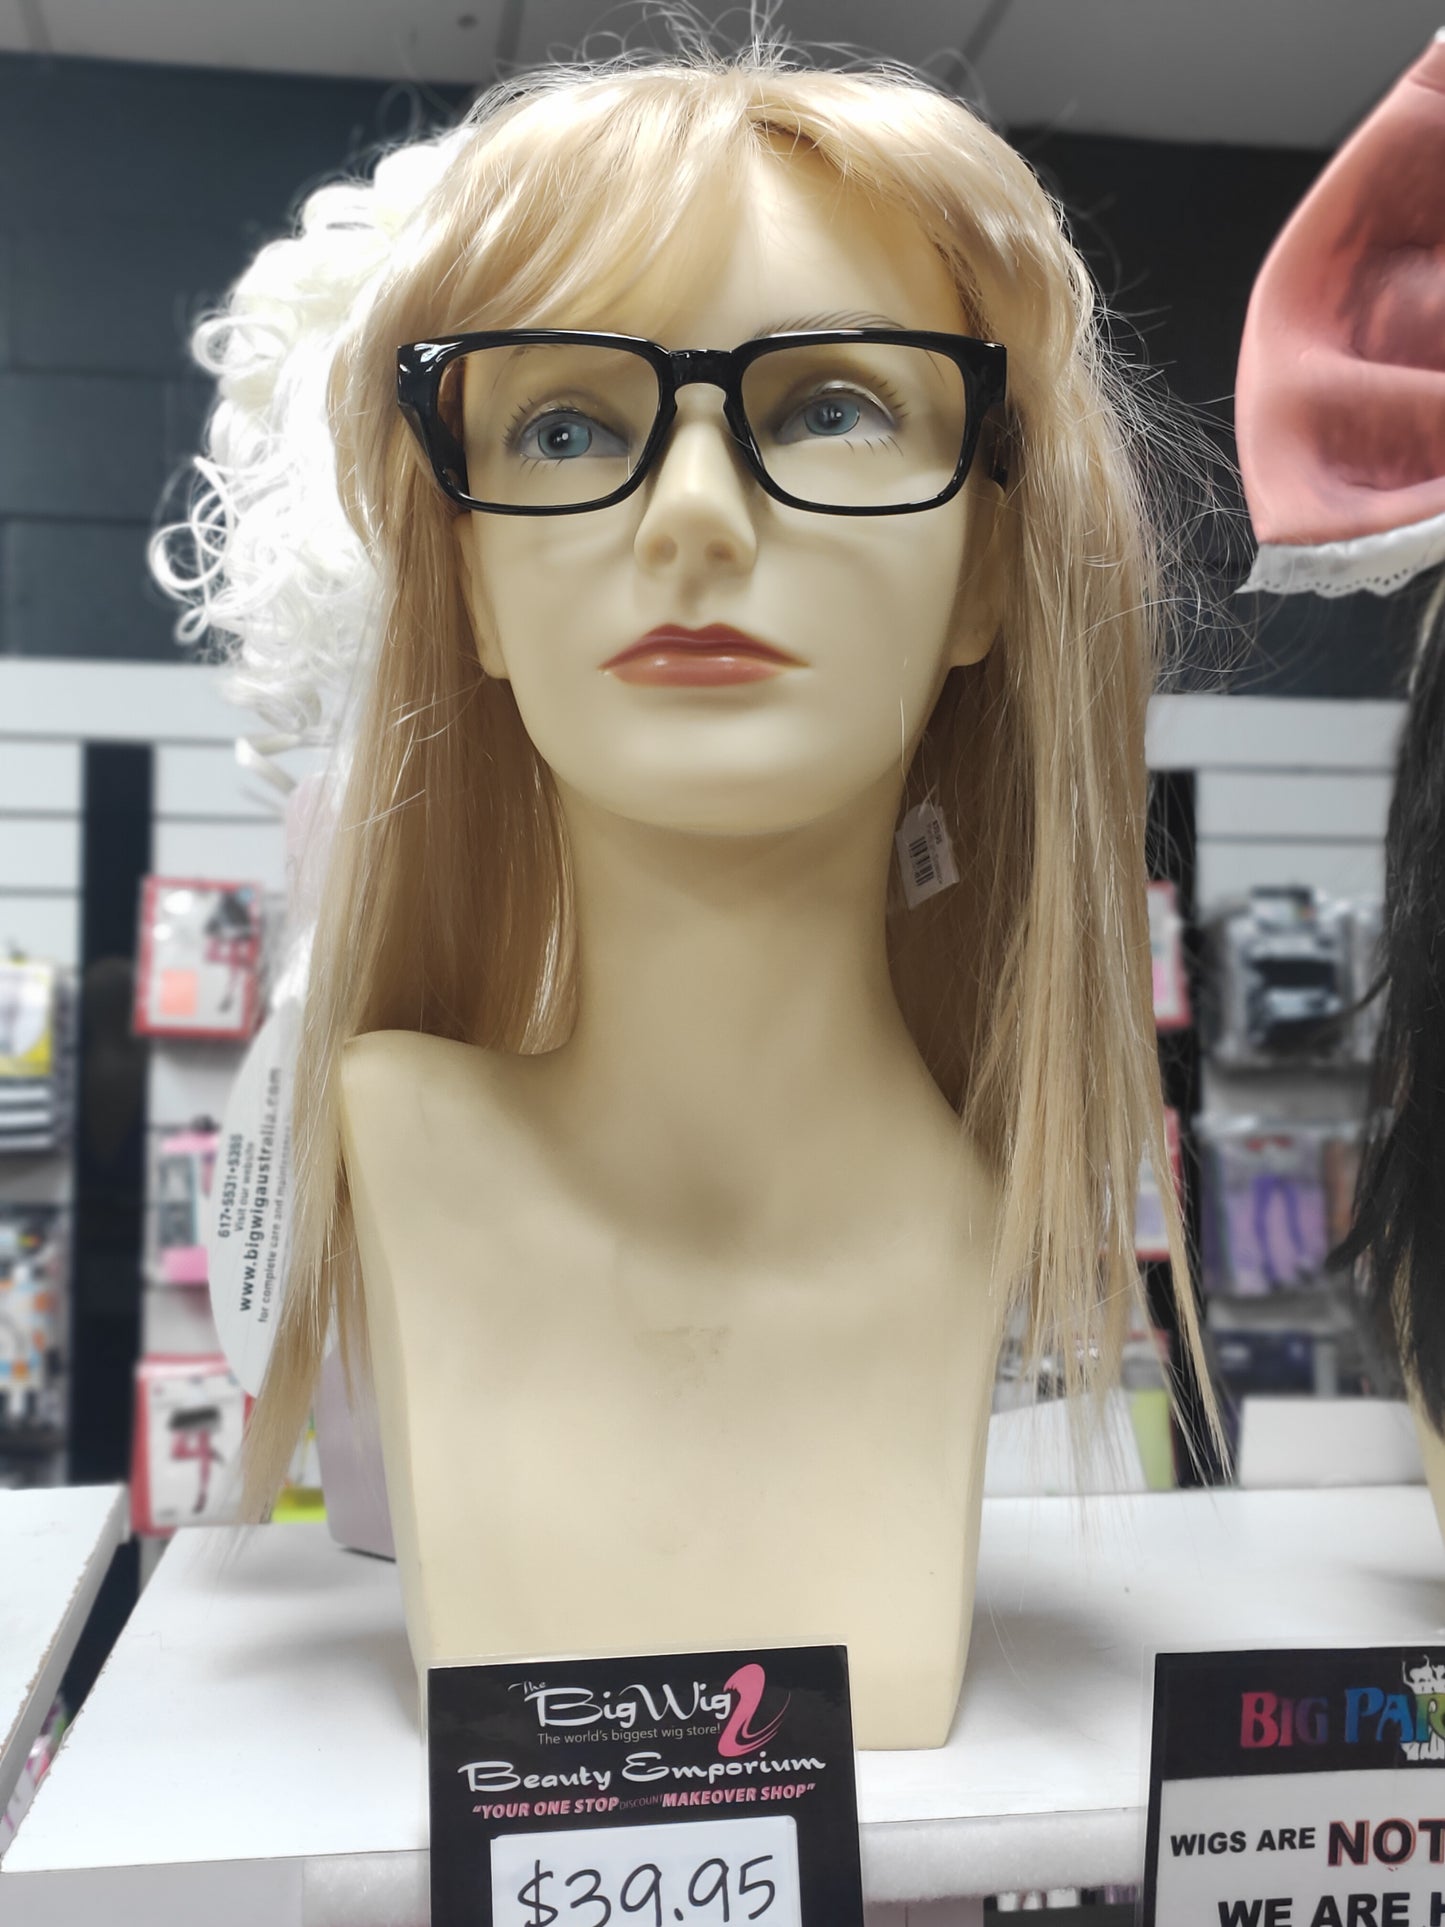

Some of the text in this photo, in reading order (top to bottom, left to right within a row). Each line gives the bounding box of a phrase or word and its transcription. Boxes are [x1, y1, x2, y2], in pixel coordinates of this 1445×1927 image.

[234, 1142, 255, 1232] Visit our website
[238, 1067, 282, 1312] www.bigwigaustralia.com
[271, 1199, 284, 1221] and
[269, 1223, 281, 1249] care
[261, 1252, 278, 1304] complete
[257, 1306, 270, 1323] for
[508, 1681, 546, 1695] The
[537, 1723, 721, 1745] The world's biggest wig store!
[1240, 1691, 1329, 1748] BIG
[457, 1751, 826, 1792] Beauty Emporium
[534, 1800, 570, 1816] ONE
[573, 1796, 619, 1814] STOP
[661, 1786, 757, 1808] MAKEOVER
[1170, 1817, 1445, 1867] WIGS ARE NOT
[517, 1855, 776, 1927] $39.95
[1218, 1897, 1293, 1927] WE
[1309, 1892, 1410, 1927] ARE
